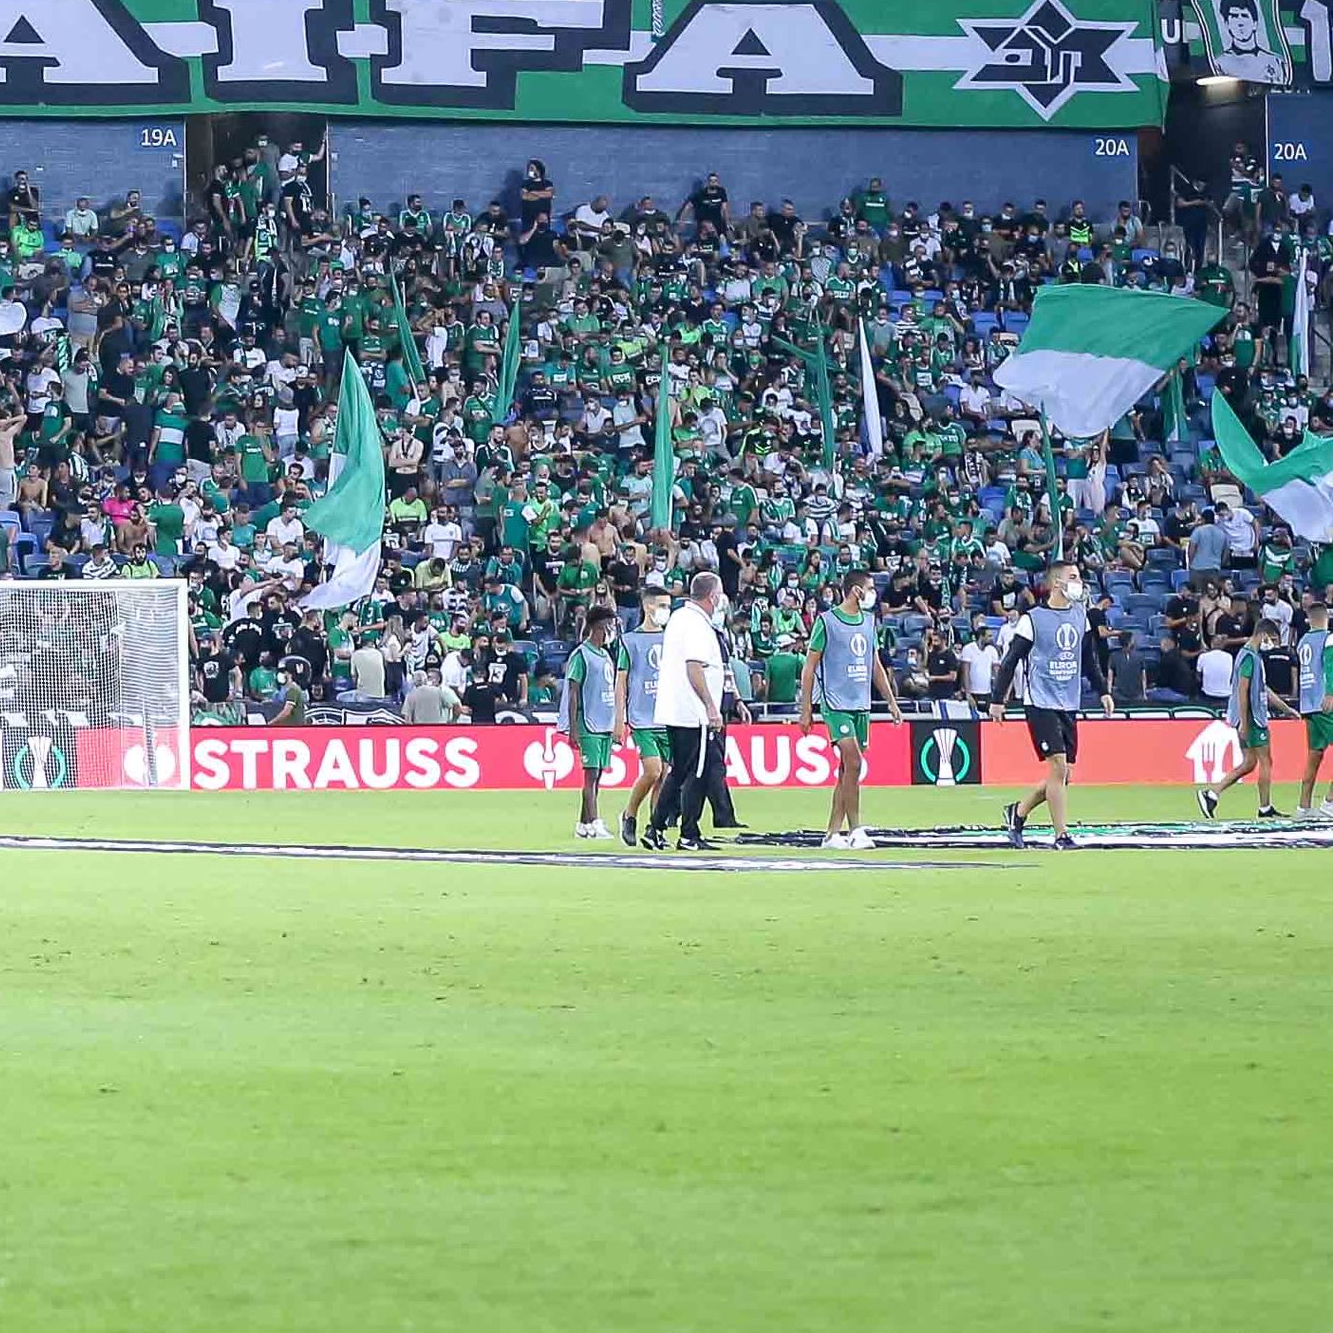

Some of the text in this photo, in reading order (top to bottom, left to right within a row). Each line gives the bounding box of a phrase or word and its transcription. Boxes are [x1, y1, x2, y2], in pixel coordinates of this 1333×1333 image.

[140, 129, 177, 147] 19A
[1094, 139, 1130, 156] 20A
[1274, 143, 1307, 162] 20A
[193, 737, 481, 791] STRAUSS
